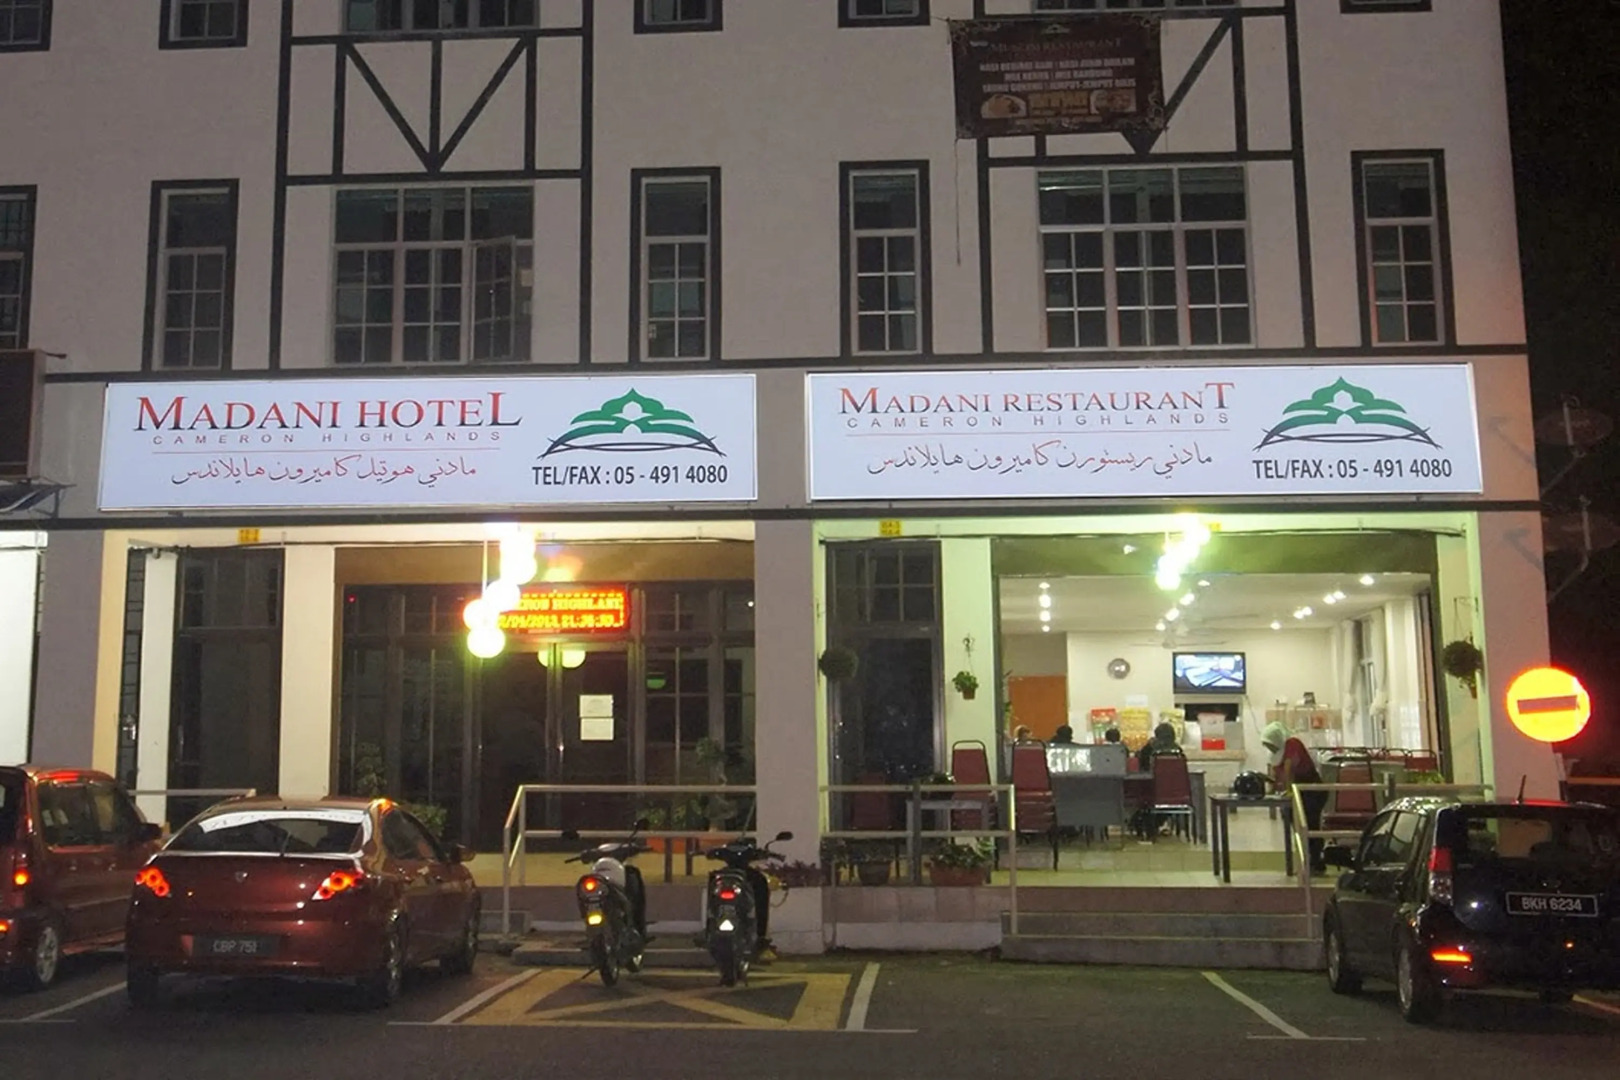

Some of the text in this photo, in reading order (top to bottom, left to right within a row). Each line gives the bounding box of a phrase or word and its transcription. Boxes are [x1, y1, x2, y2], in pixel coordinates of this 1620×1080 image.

[838, 382, 1235, 415] MADANI RESTAURANT
[133, 391, 522, 432] MADANI HOTEL
[846, 411, 1229, 429] CAMERON HIGHLANDS
[153, 430, 500, 446] CAMERON HIGHLANDS
[613, 466, 635, 485] 05
[649, 465, 679, 485] 491
[685, 464, 728, 484] 4080
[1336, 460, 1359, 479] 05
[1373, 459, 1404, 479] 491
[1409, 458, 1452, 478] 4080
[1521, 896, 1583, 911] BKH 6234
